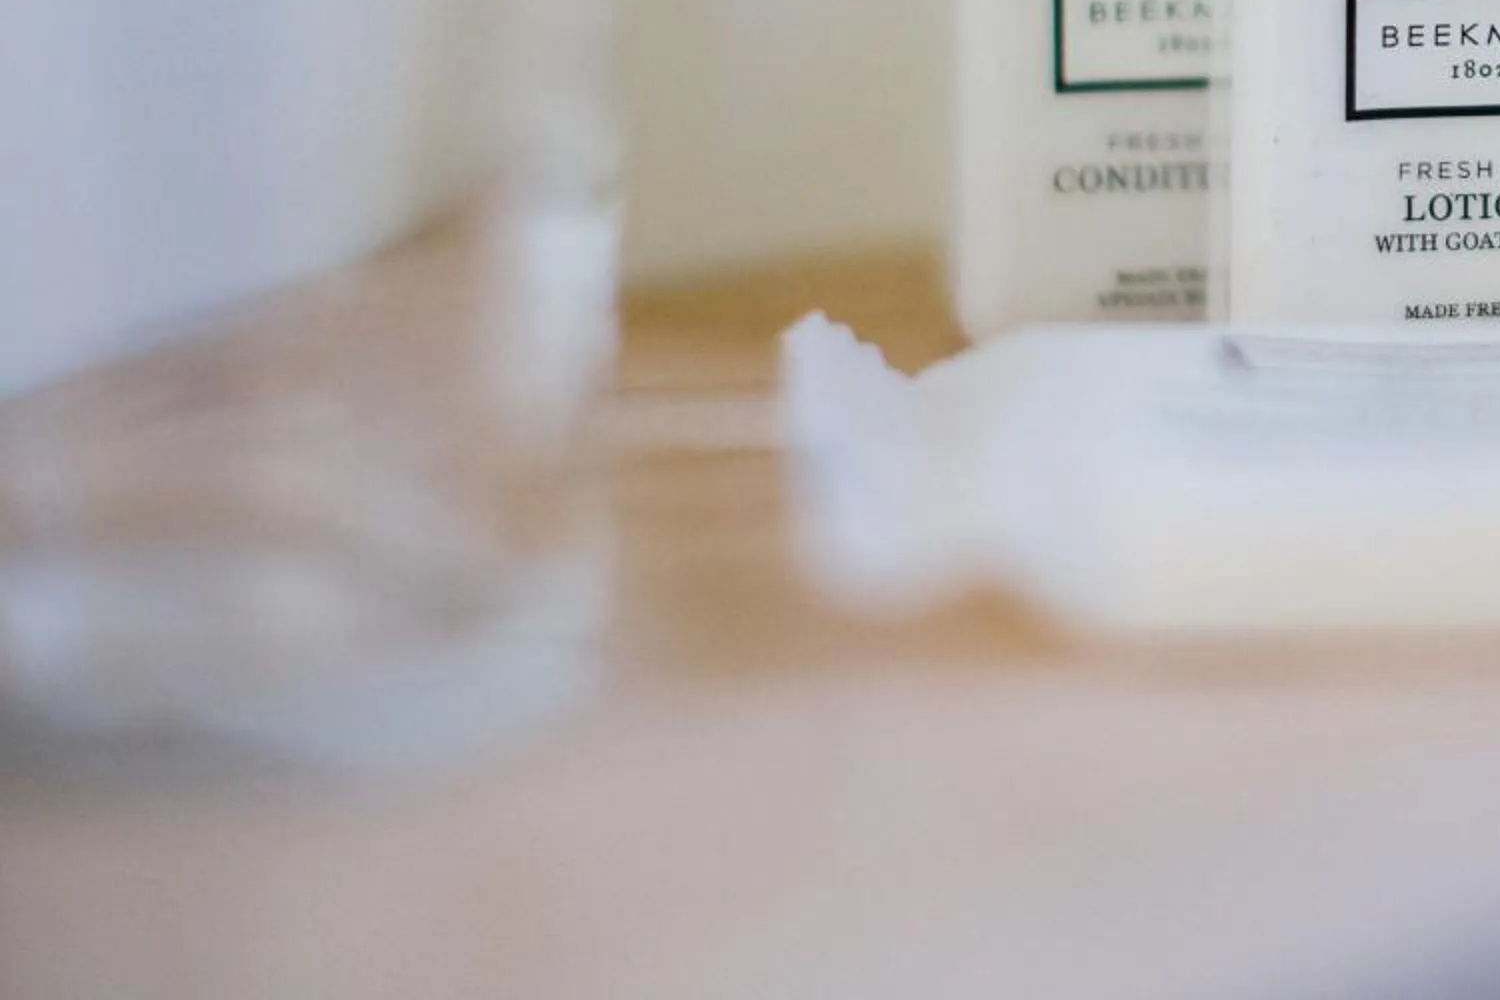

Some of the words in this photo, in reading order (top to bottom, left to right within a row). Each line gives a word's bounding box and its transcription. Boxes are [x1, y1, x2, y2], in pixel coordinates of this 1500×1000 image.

[1398, 161, 1493, 180] FRESH
[1374, 233, 1439, 254] WITH
[1404, 303, 1460, 321] MADE
